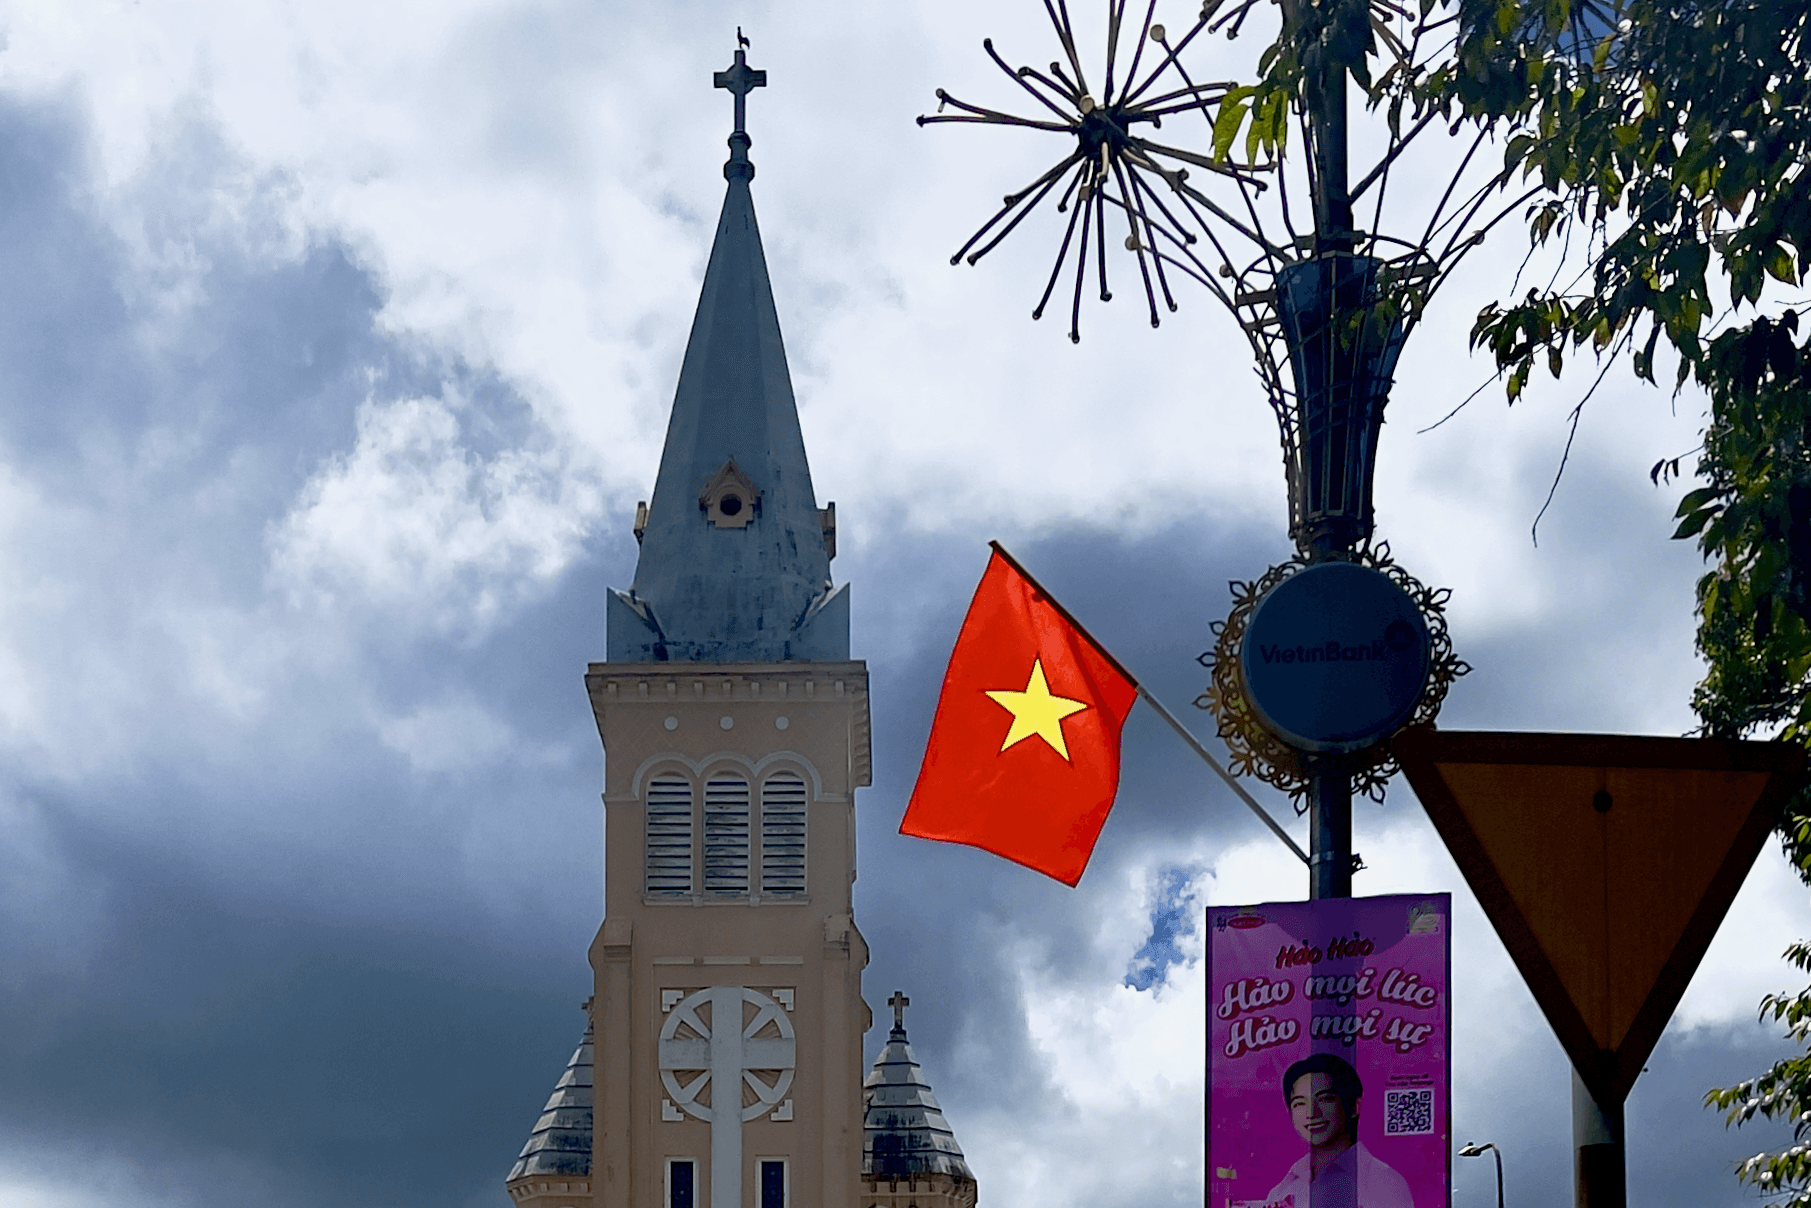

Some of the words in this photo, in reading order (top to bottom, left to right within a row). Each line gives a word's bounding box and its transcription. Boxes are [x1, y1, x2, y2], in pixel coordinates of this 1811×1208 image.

[1259, 640, 1386, 664] VietinBank
[1303, 968, 1375, 1004] mọi
[1379, 968, 1437, 1007] lúc
[1311, 1009, 1381, 1044] mọi
[1384, 1017, 1432, 1052] sự
